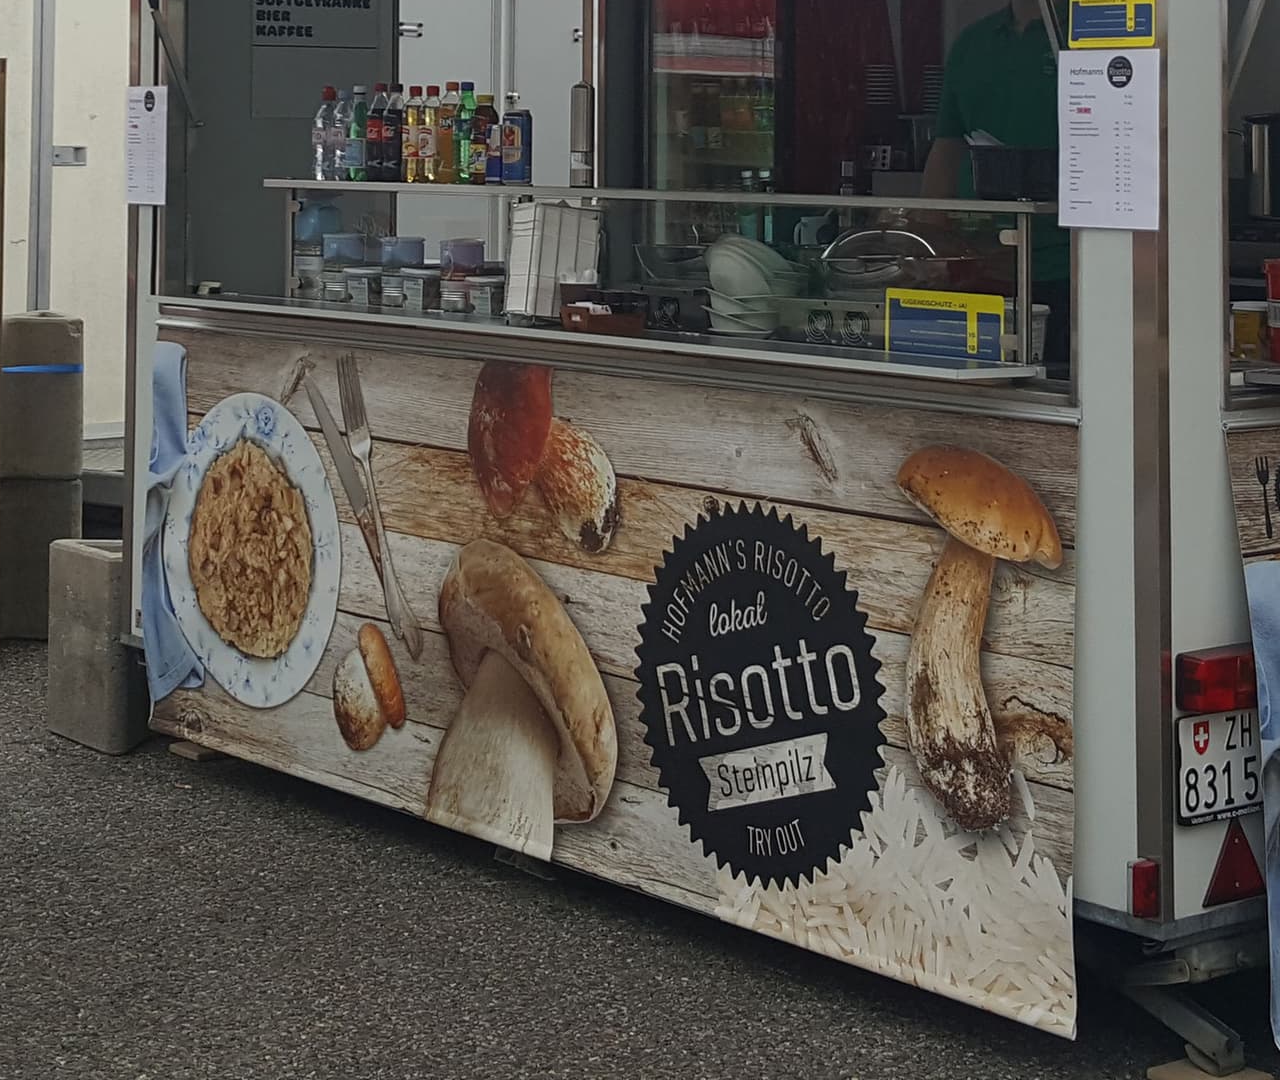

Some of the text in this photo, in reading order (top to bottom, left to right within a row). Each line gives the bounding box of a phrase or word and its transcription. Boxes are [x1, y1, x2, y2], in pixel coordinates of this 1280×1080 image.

[256, 10, 291, 22] BIER
[256, 25, 313, 37] KAFFEE
[660, 540, 831, 644] HOFMANN'S RISOTTO
[708, 590, 768, 637] lokal
[655, 639, 862, 748] Risotto
[1225, 713, 1252, 751] ZH
[717, 748, 817, 798] Steinpilz
[1185, 755, 1259, 813] 8315
[746, 818, 806, 857] TRY OUT
